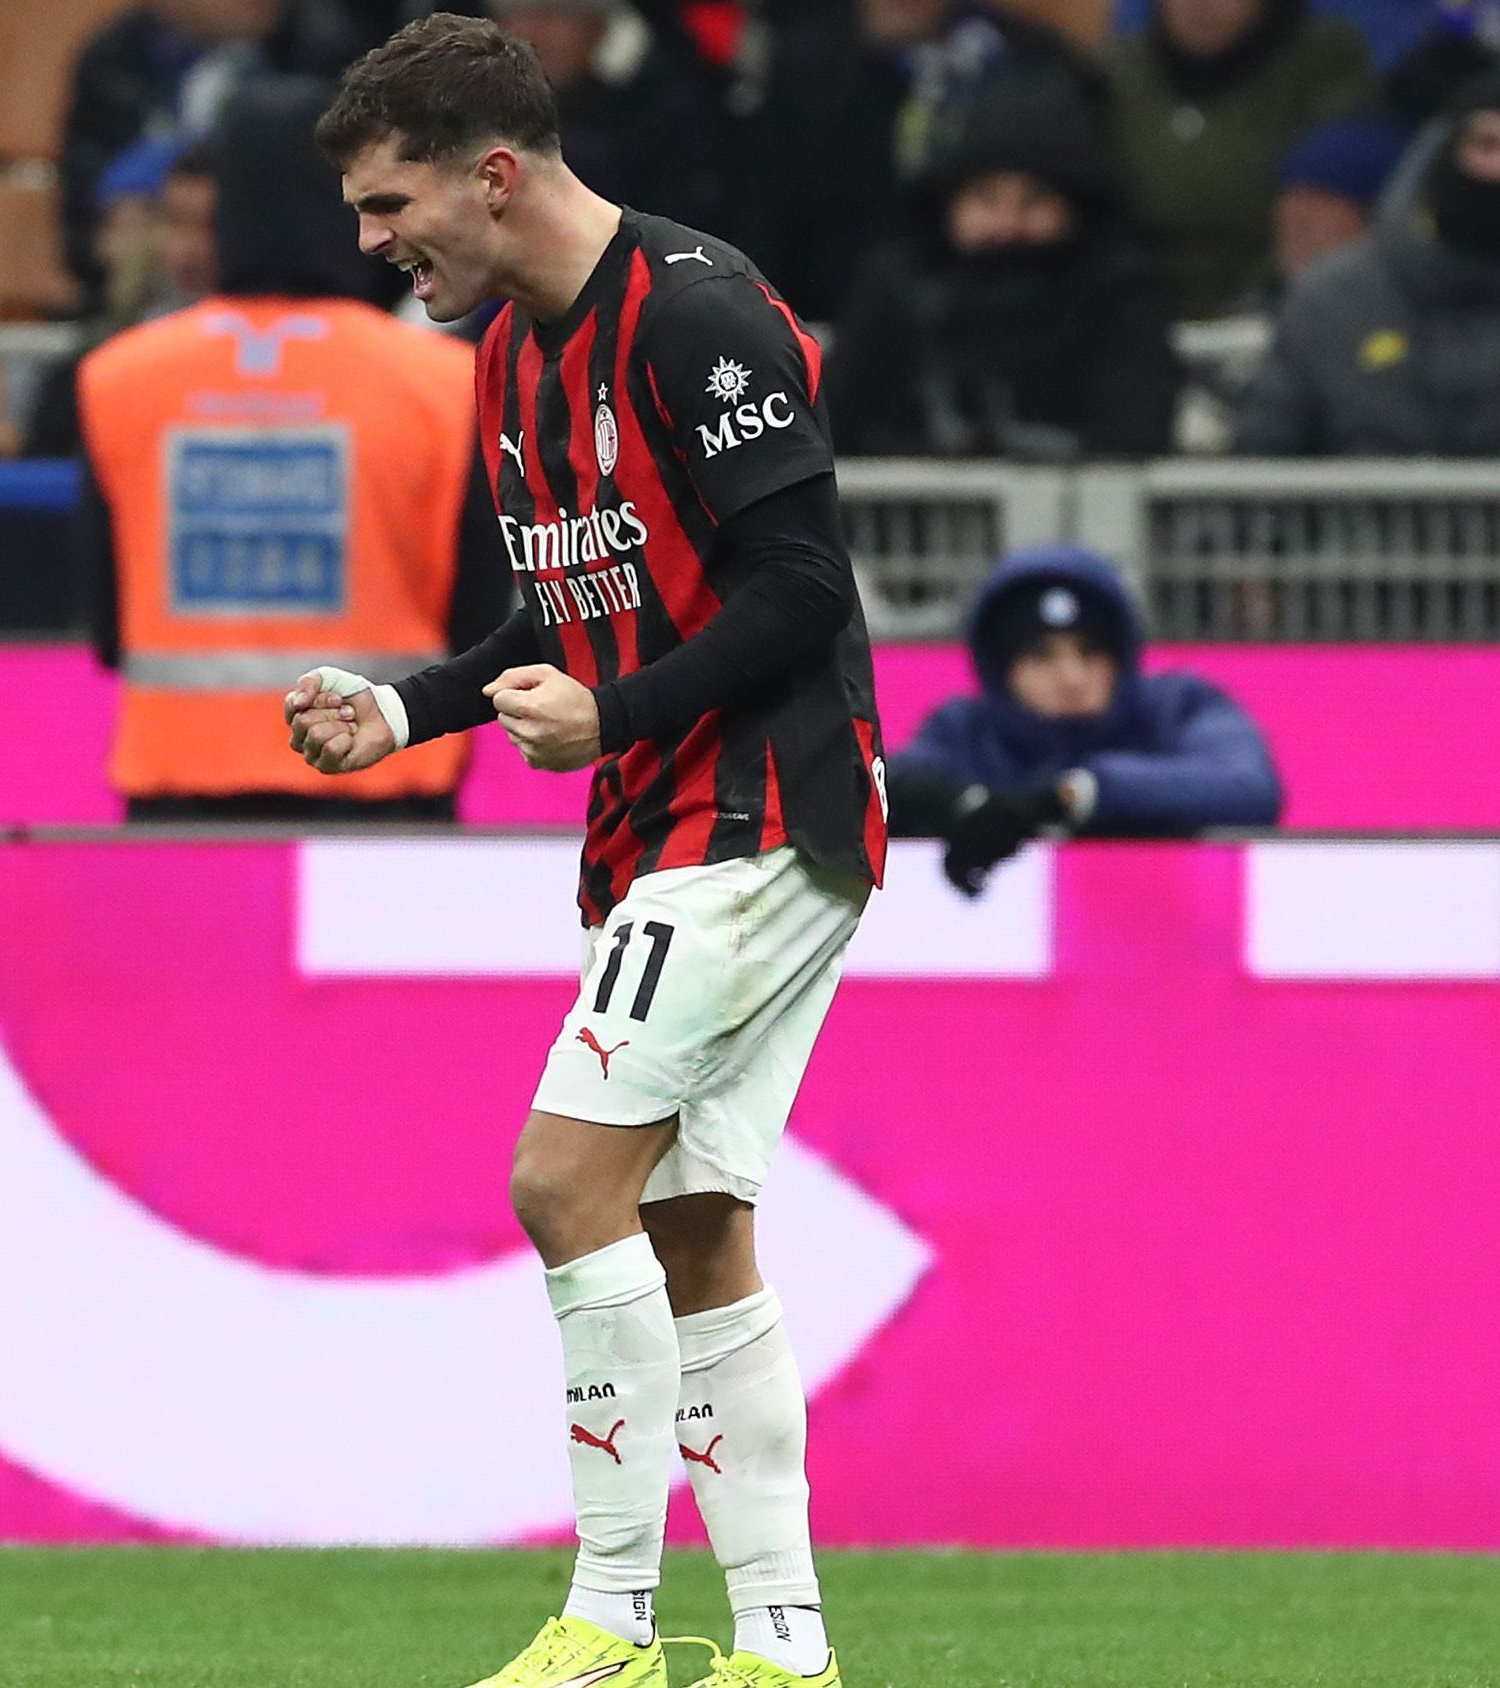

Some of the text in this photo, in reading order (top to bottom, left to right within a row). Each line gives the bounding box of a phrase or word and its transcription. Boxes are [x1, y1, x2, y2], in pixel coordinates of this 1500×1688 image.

[695, 391, 795, 459] MSC
[498, 501, 648, 572] Emirates
[535, 563, 641, 626] FLY BETTER
[593, 920, 675, 1022] 11
